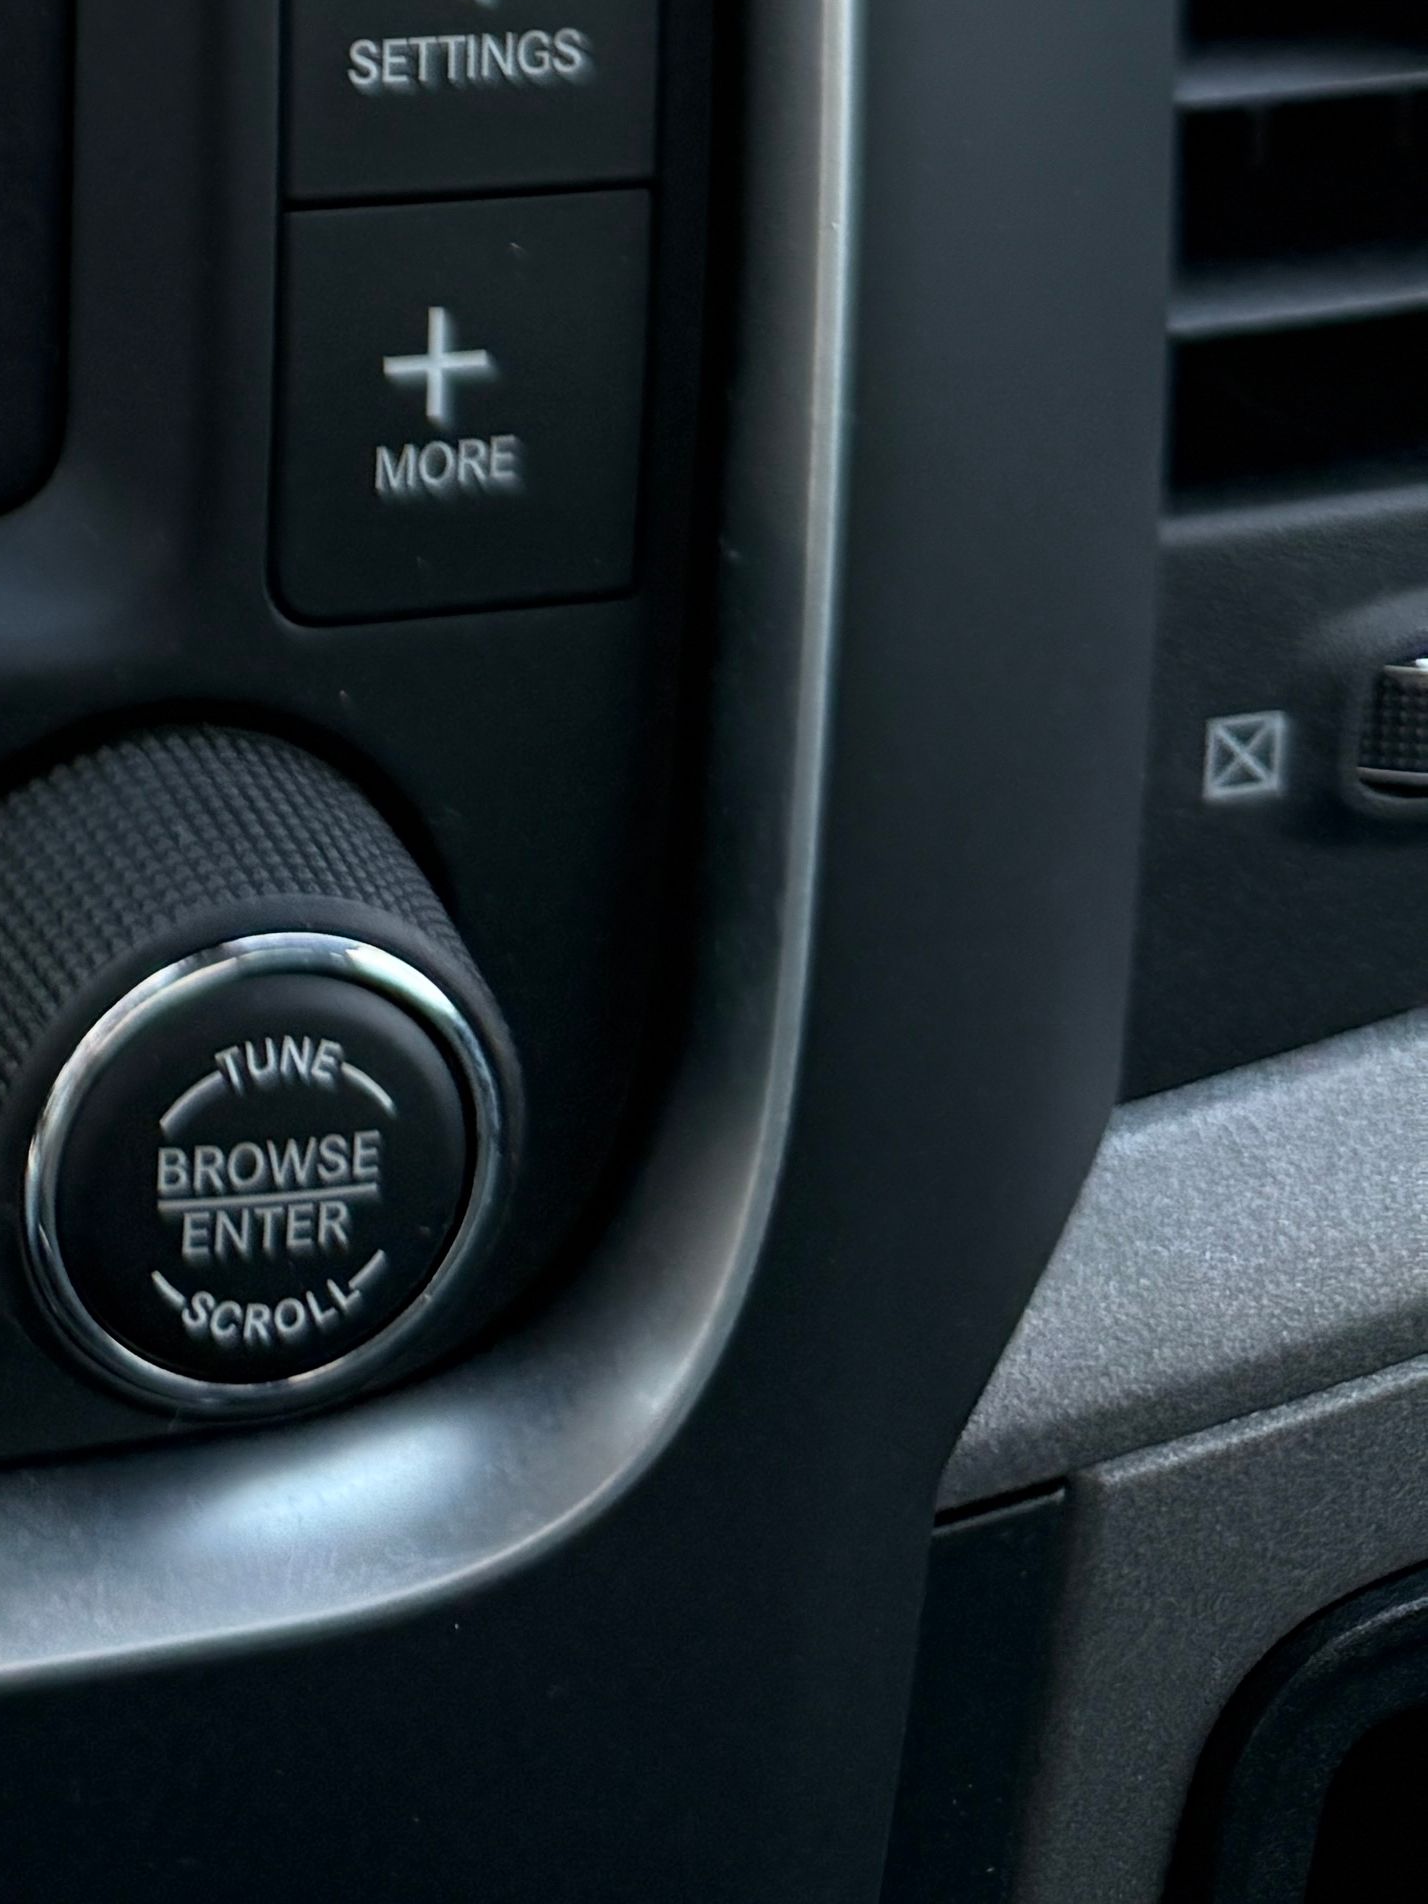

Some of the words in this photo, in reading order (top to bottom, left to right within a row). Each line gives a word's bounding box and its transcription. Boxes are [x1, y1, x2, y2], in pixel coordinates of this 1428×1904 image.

[348, 28, 586, 88] SETTINGS
[376, 436, 515, 492] MORE
[215, 1035, 344, 1092] TUNE
[158, 1128, 380, 1192] BROWSE
[182, 1200, 350, 1258] ENTER
[181, 1279, 361, 1345] SCROLL
